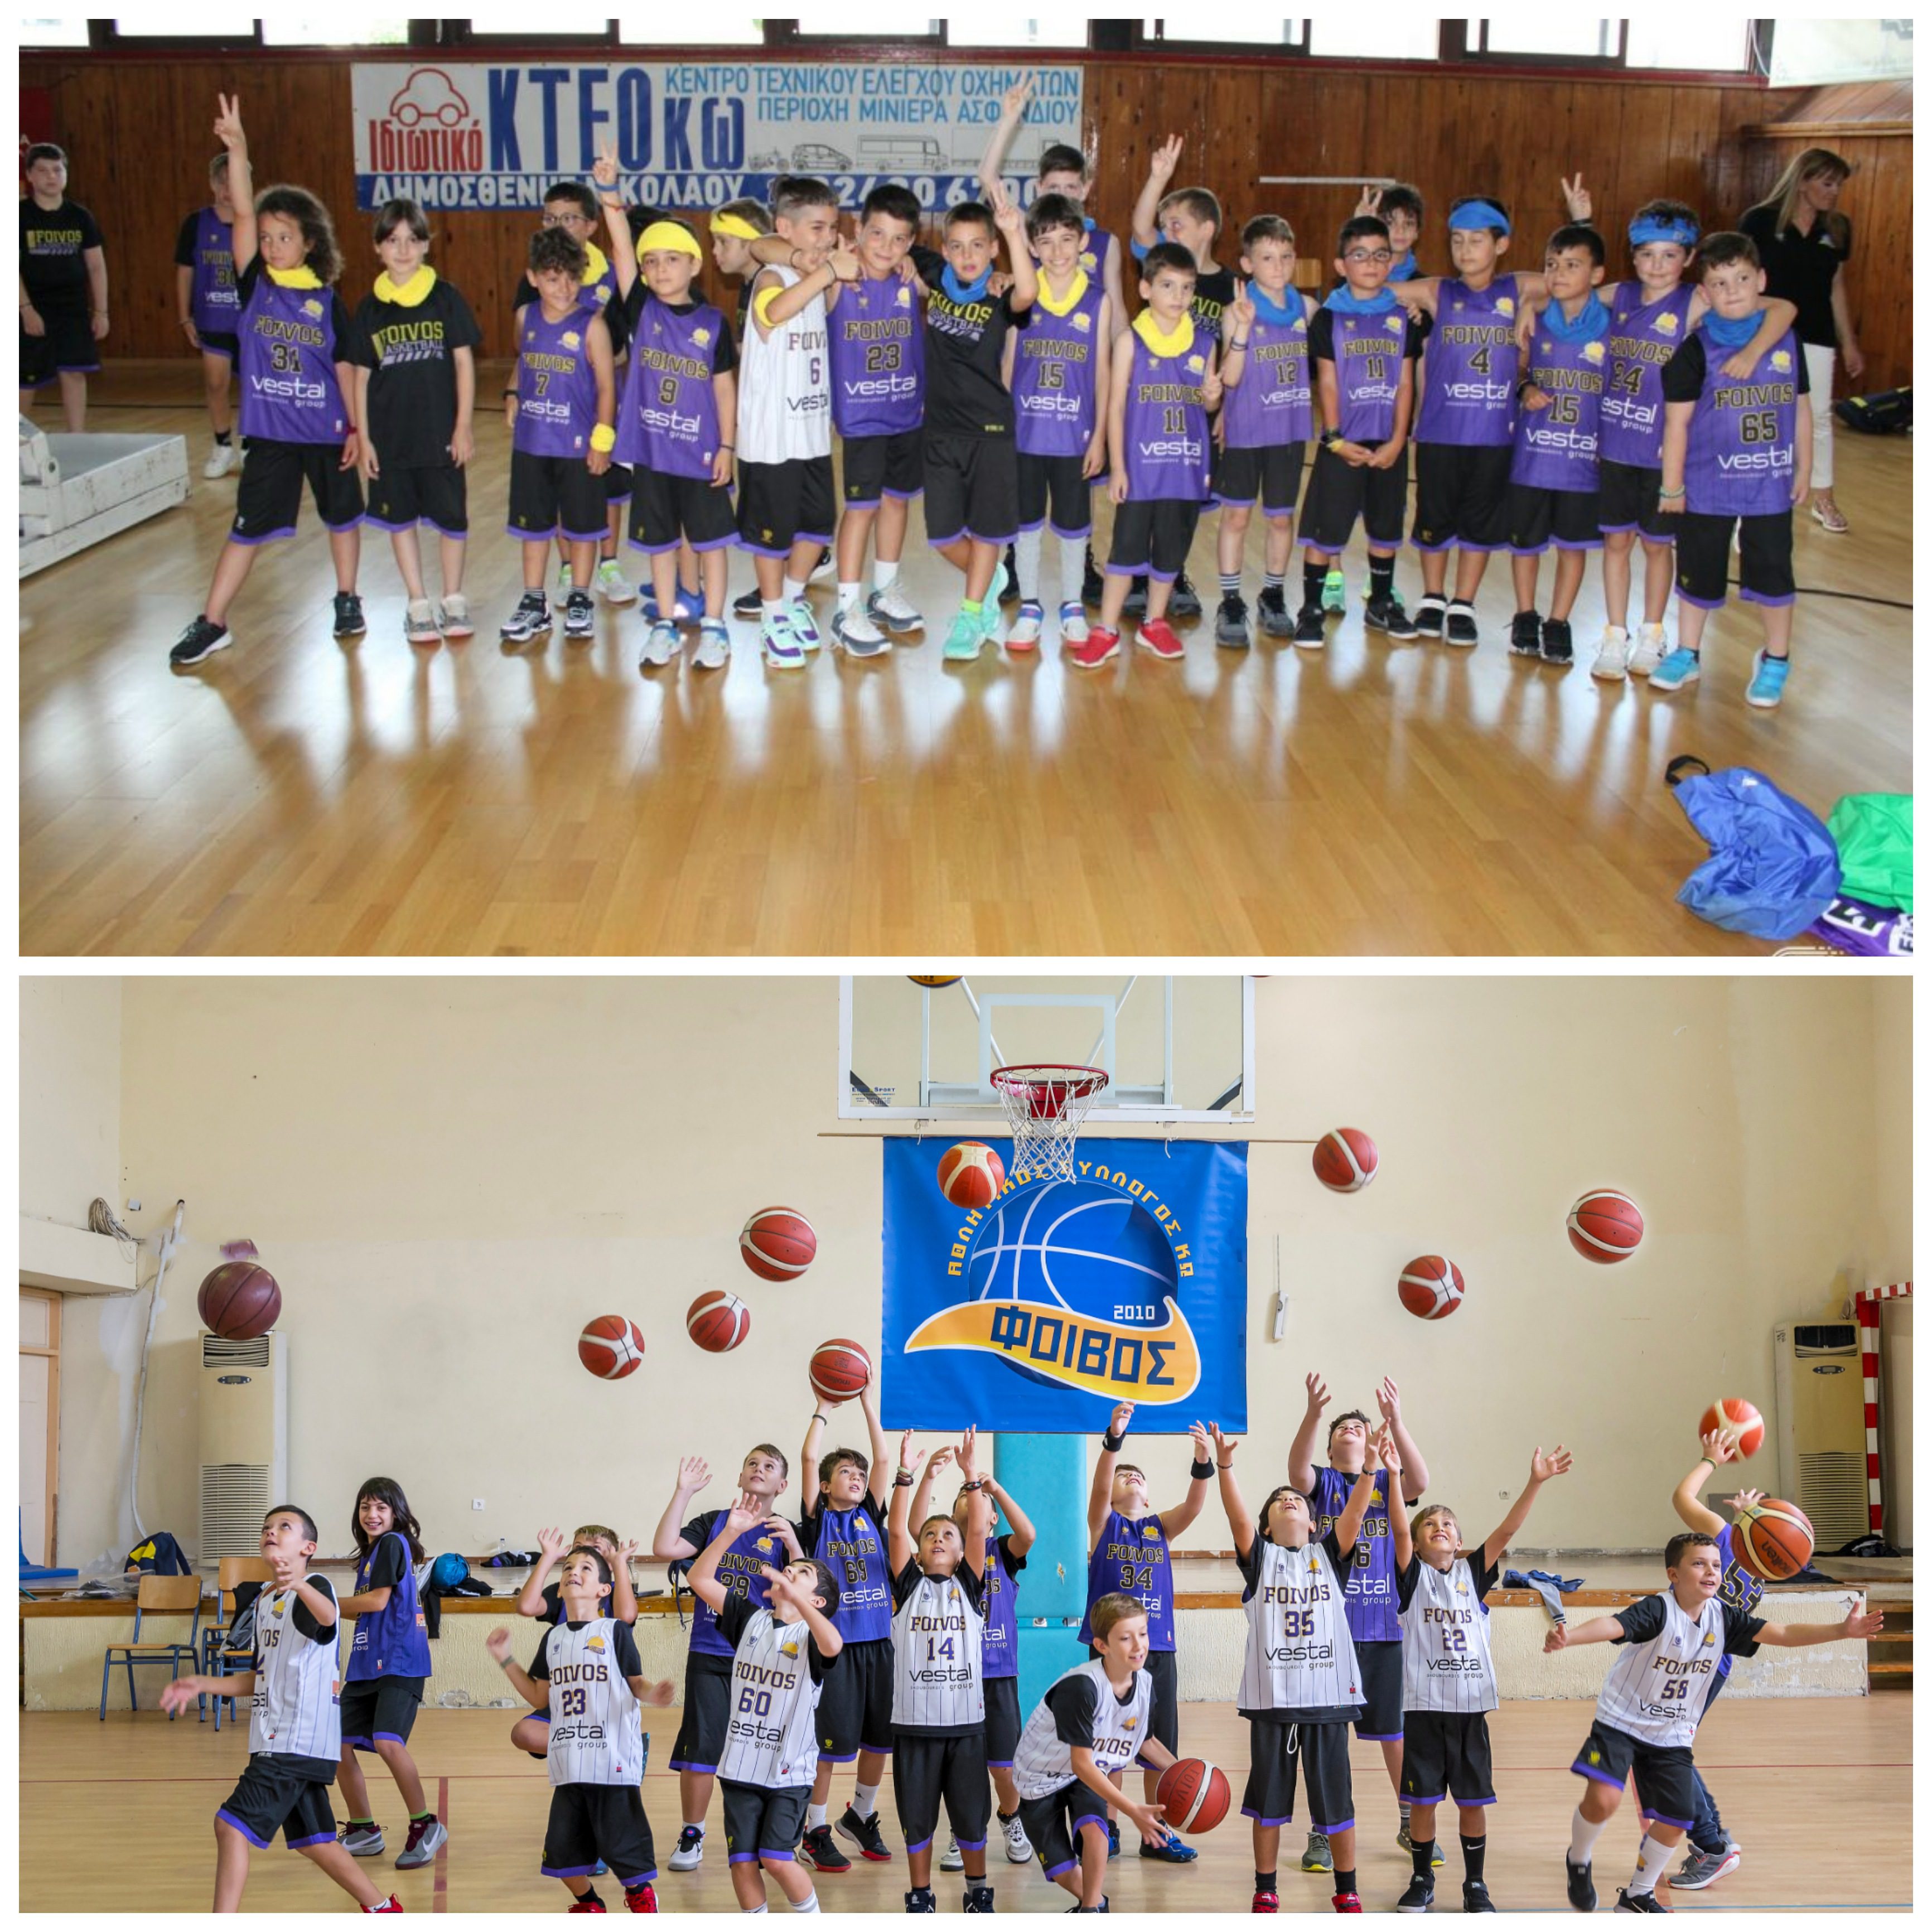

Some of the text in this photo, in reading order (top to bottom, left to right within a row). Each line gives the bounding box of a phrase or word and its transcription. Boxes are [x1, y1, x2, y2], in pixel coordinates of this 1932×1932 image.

[665, 66, 749, 94] ΚΕΝΤΡΟ
[753, 67, 858, 95] ΤΕΧΝΙΚΟΥ
[863, 69, 956, 96] ΕΛΕΓΧΟΥ
[757, 97, 1078, 124] ΠΕΡΙΟΧΗ ΜΙΝΙΕΡΑ ΑΣΦΝΔΙΟΥ
[369, 119, 484, 172] Ιδιωτικό
[372, 175, 576, 207] ΔΗΜΟΣΘΕΝΗ
[587, 175, 743, 206] ΚΟΛΑΟΥ
[254, 315, 325, 347] FOIVOS
[844, 318, 912, 340] FOIVO
[272, 344, 302, 374] 31
[866, 343, 902, 373] 23
[1023, 339, 1088, 361] FOIVOS
[1468, 346, 1491, 376] 4
[641, 346, 710, 380] FOIVOS
[810, 356, 820, 385] 6
[1038, 361, 1065, 389] 15
[1276, 361, 1297, 385] 12
[1366, 355, 1386, 380] 11
[252, 374, 326, 399] vestal
[535, 373, 549, 396] 7
[659, 376, 679, 405] 9
[1260, 385, 1311, 405] vesta
[1714, 383, 1795, 409] FOIVOS
[1020, 392, 1080, 413] vestal
[1548, 393, 1581, 424] 15
[1601, 397, 1658, 425] estal
[1163, 406, 1187, 434] 11
[1741, 412, 1778, 443] 65
[1717, 443, 1793, 470] vestal
[1114, 1305, 1156, 1321] 2010
[991, 1305, 1176, 1386] ΦΟΙΒΟΣ
[1107, 1543, 1163, 1563] FOIVOS
[1354, 1541, 1371, 1568] 6
[845, 1558, 868, 1584] 69
[1120, 1564, 1153, 1590] 34
[1264, 1583, 1331, 1604] FOIVOS
[1345, 1573, 1390, 1595] stal
[866, 1600, 889, 1611] group
[1363, 1597, 1391, 1606] group
[910, 1616, 966, 1632] FOIVOS
[1147, 1611, 1161, 1620] roup
[1284, 1609, 1315, 1638] 35
[926, 1636, 955, 1661] 14
[986, 1642, 1007, 1650] group
[1264, 1638, 1333, 1661] vestal
[1442, 1628, 1467, 1651] 22
[909, 1662, 972, 1682] vestal
[1309, 1661, 1334, 1670] group
[1426, 1654, 1482, 1671] vestal
[736, 1661, 796, 1690] FOIVOS
[949, 1682, 973, 1691] group
[738, 1686, 772, 1717] 60
[1661, 1679, 1689, 1699] 58
[561, 1688, 586, 1717] 23
[731, 1718, 786, 1743] estal
[577, 1741, 608, 1750] group
[755, 1741, 781, 1753] group
